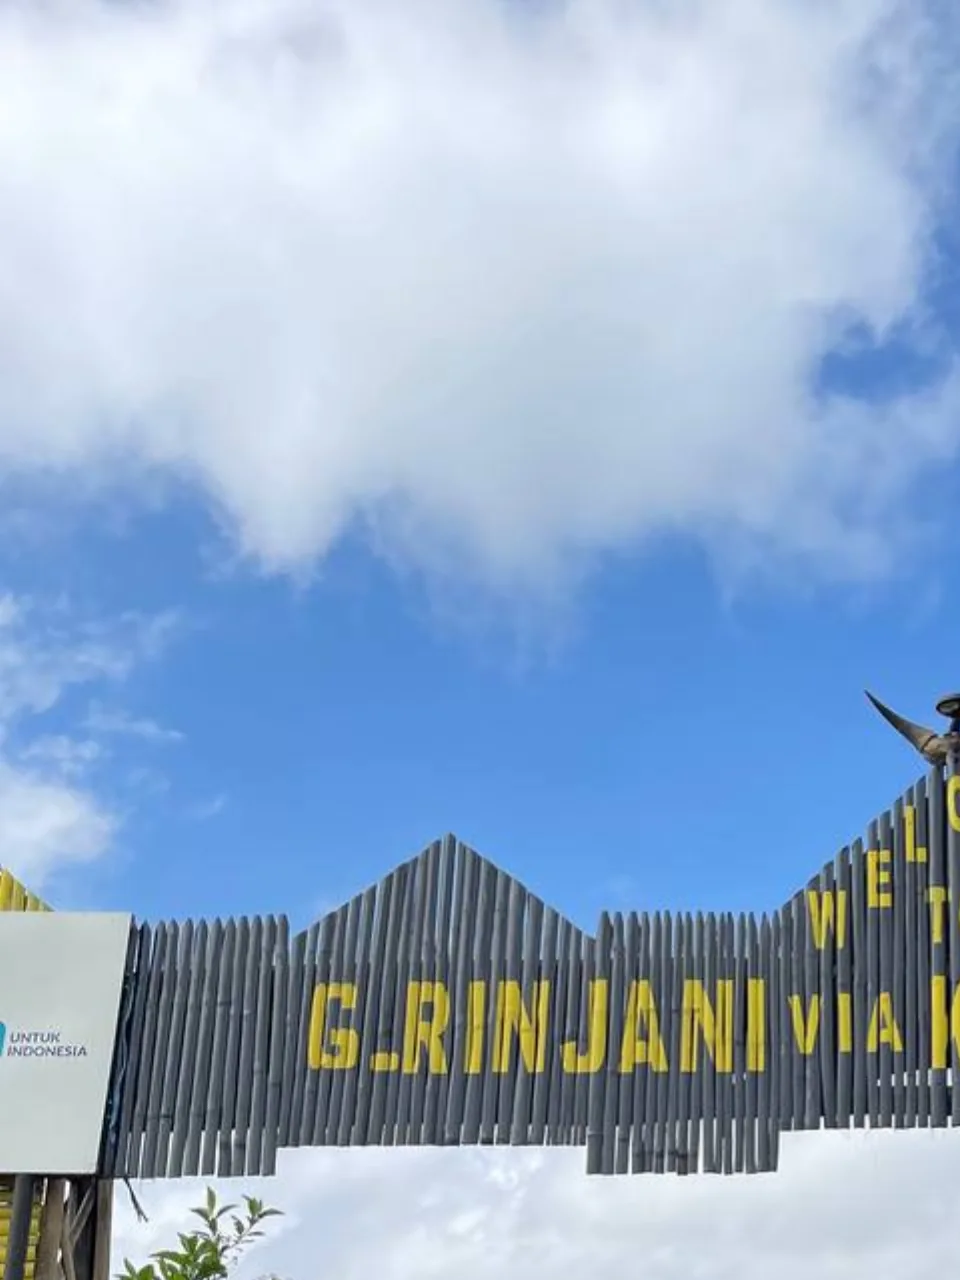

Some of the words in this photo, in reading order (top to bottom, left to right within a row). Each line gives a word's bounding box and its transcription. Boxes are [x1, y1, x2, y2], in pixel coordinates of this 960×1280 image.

[789, 992, 904, 1055] VIA
[10, 1032, 61, 1043] UNTUK
[7, 1044, 88, 1057] INDONESIA
